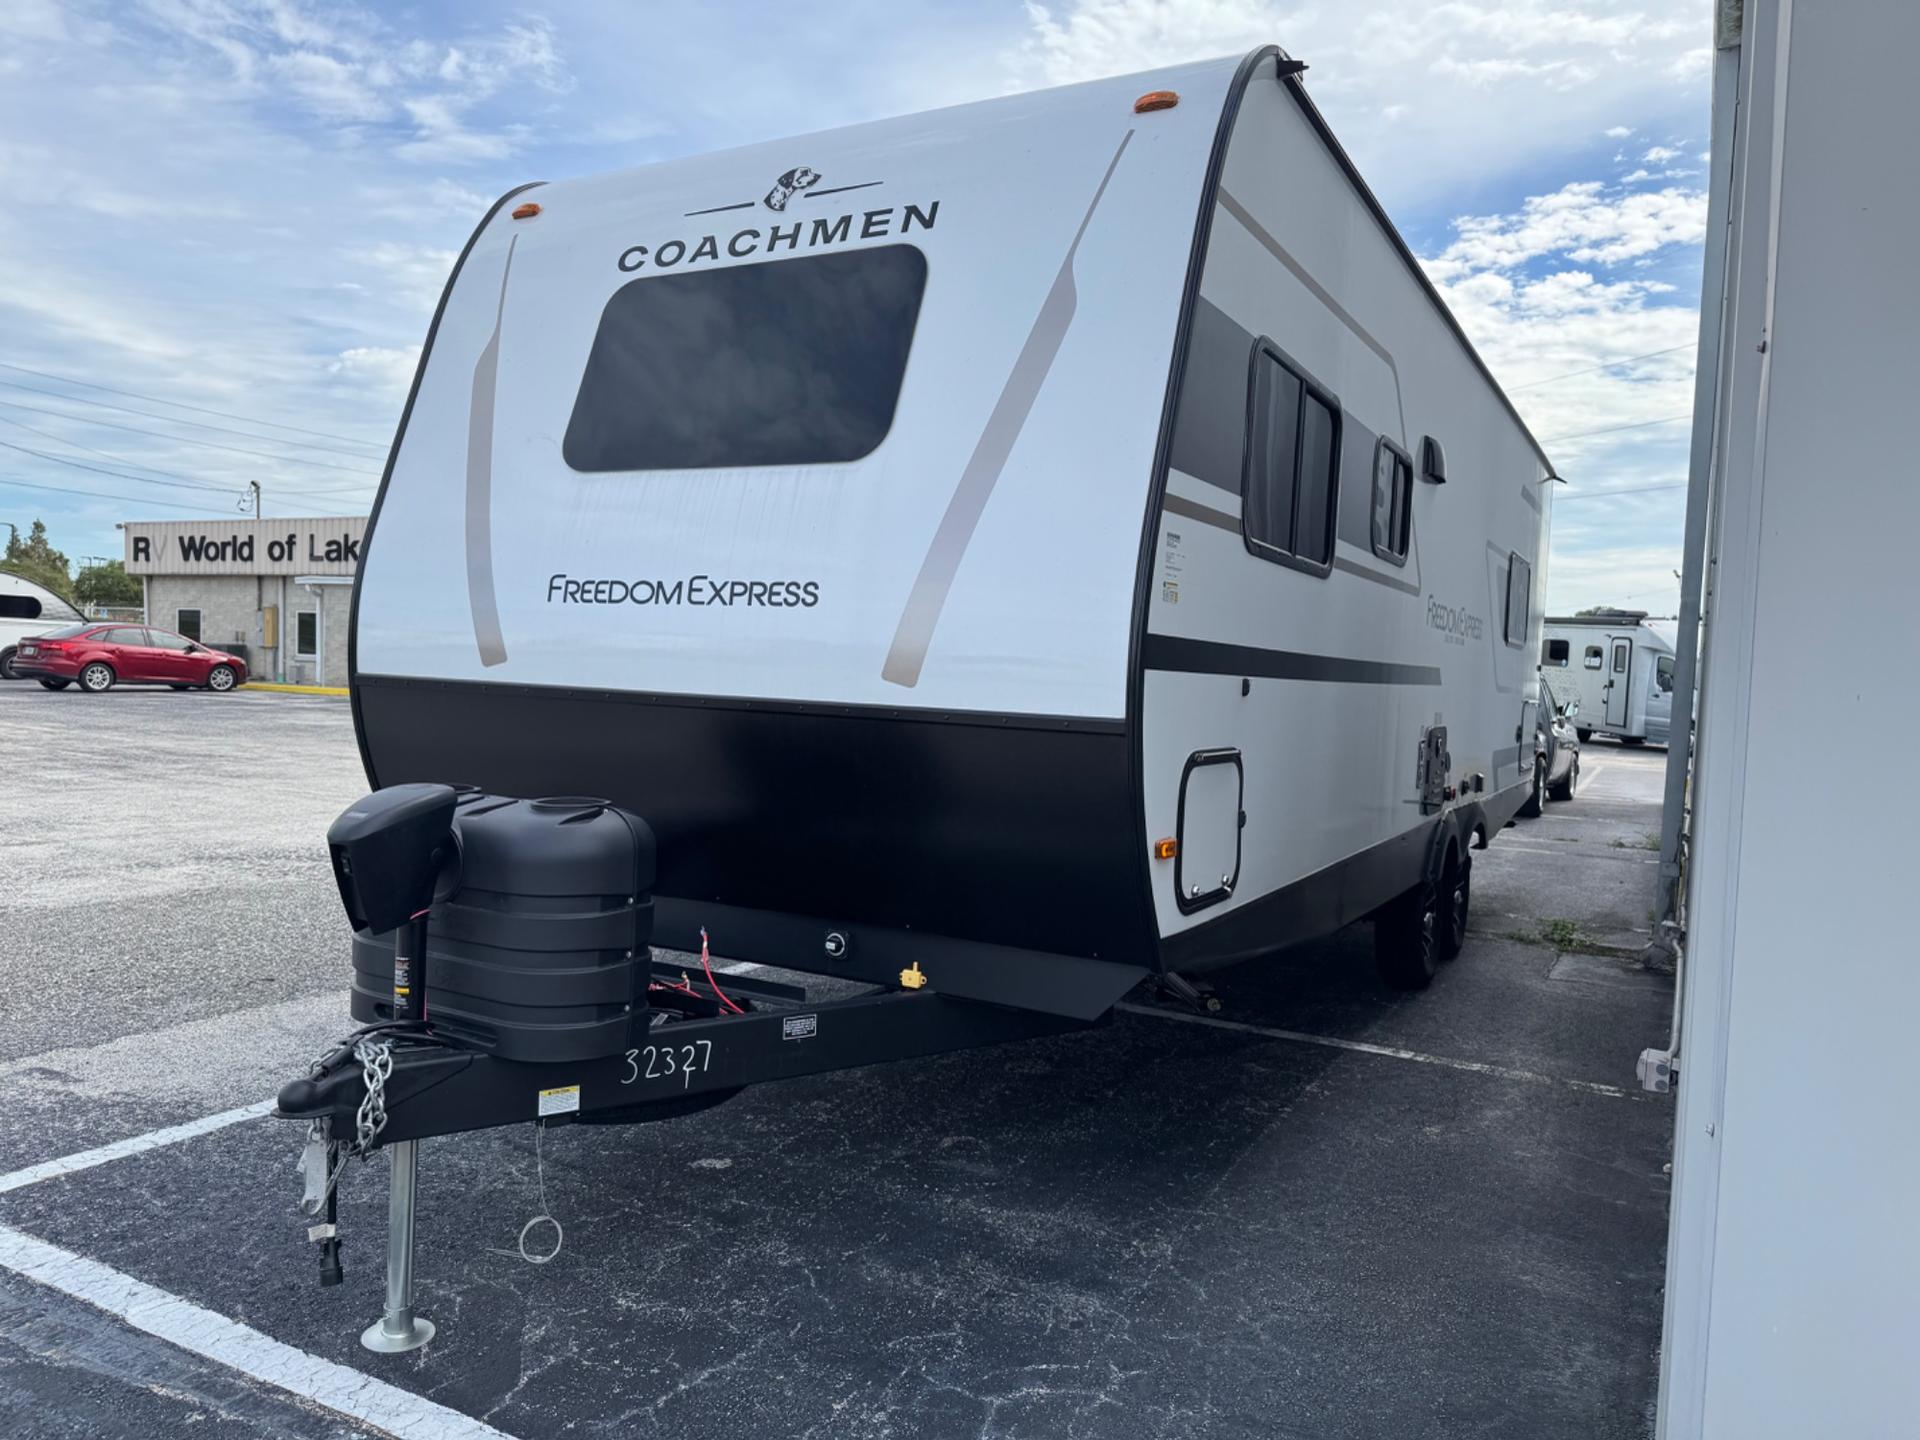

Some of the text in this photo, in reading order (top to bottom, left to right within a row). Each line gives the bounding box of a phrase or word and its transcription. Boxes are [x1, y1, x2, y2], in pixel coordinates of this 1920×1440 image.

[618, 201, 940, 272] COACHMEN
[178, 535, 254, 562] World
[268, 534, 297, 561] of
[620, 1040, 712, 1089] 32327
